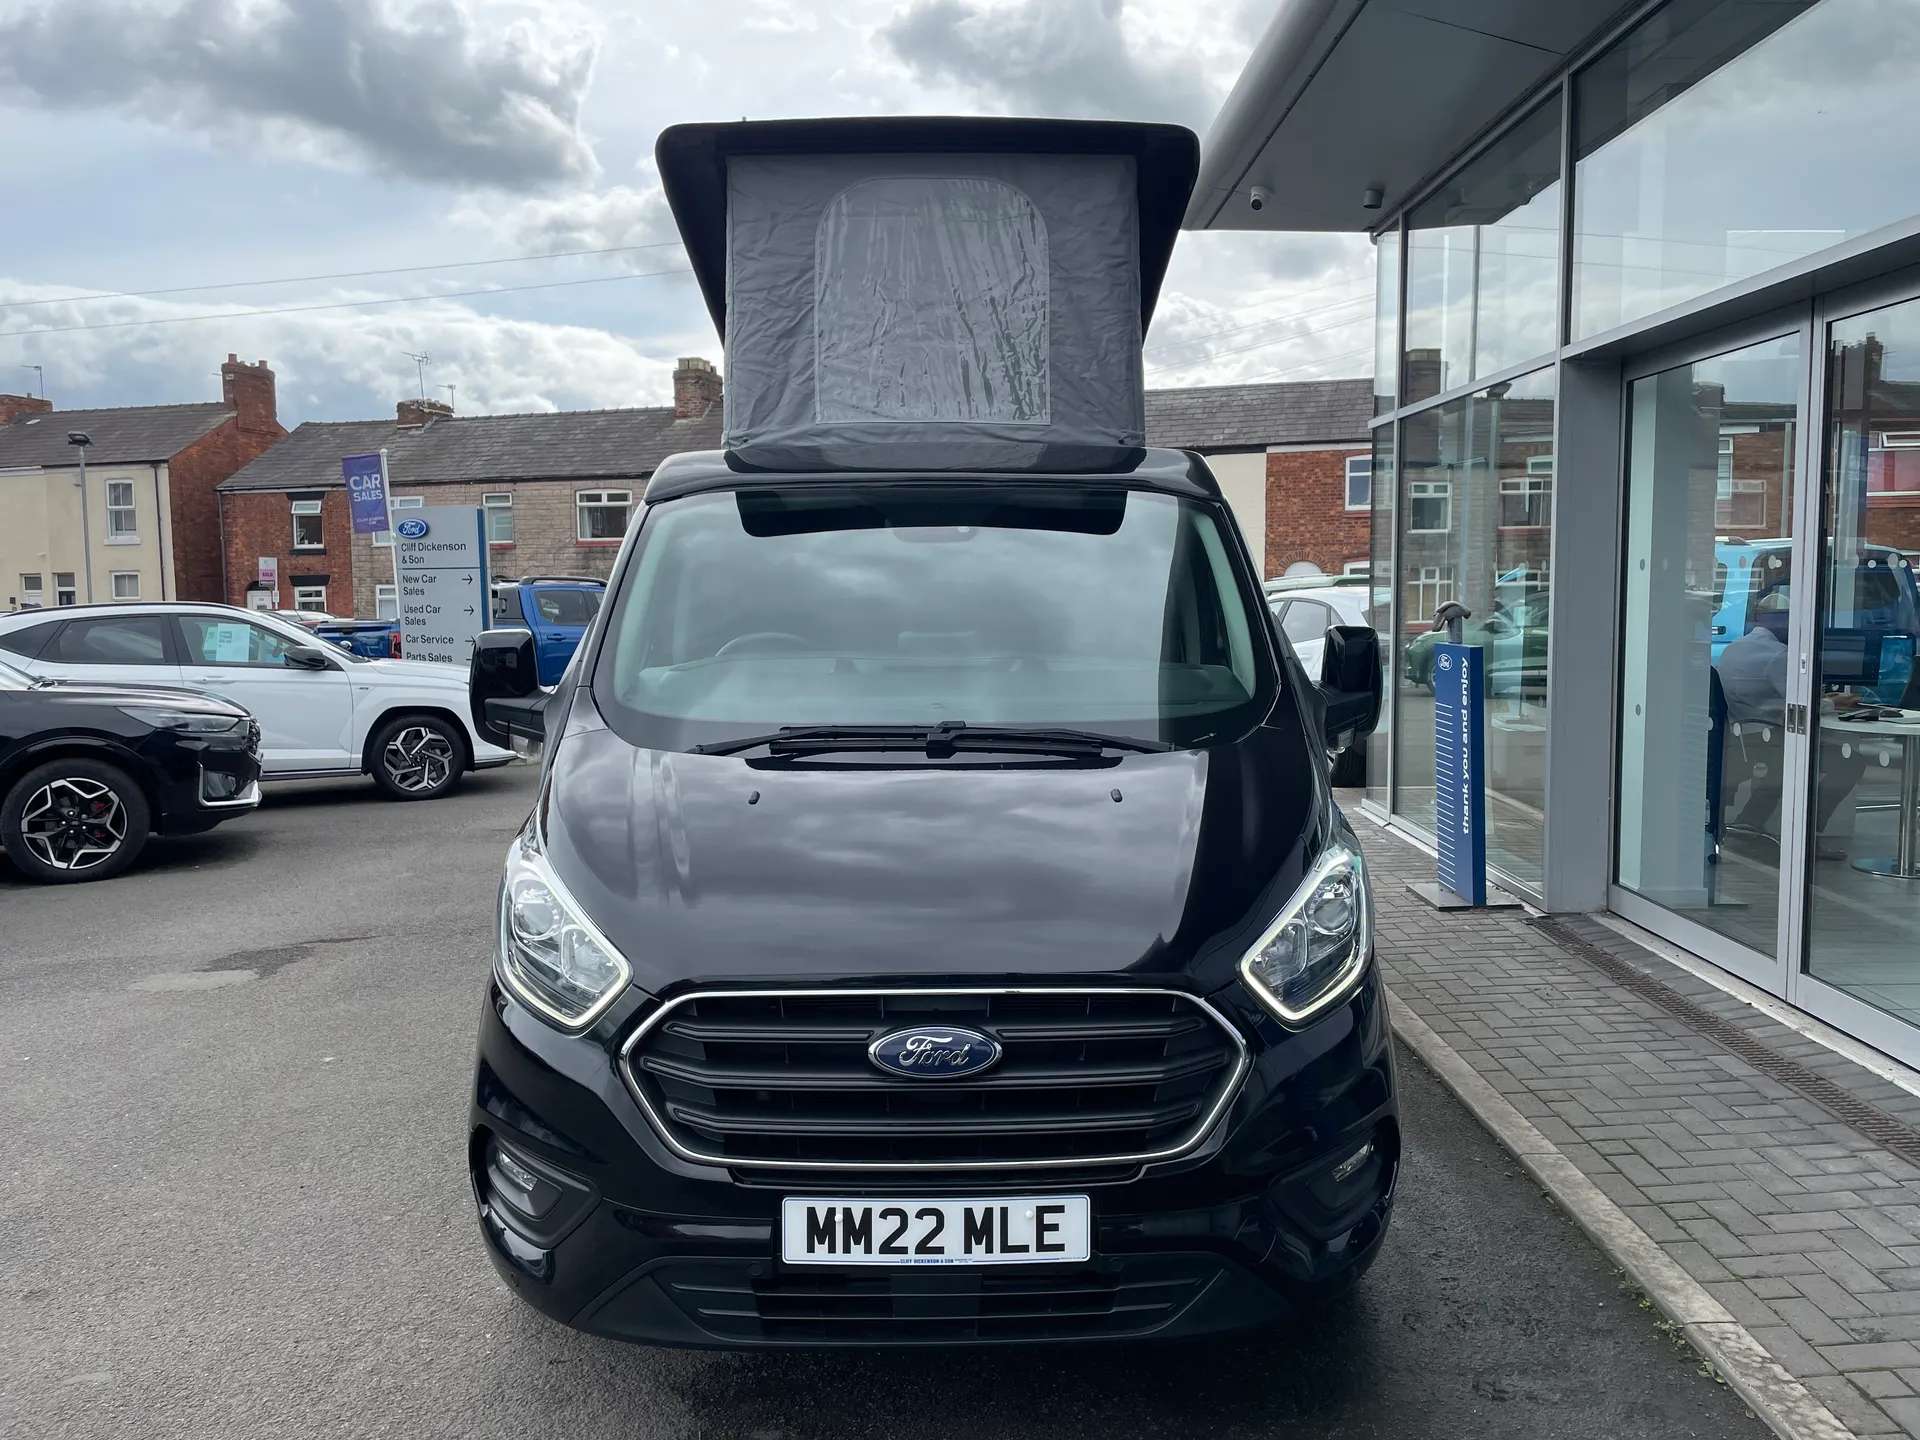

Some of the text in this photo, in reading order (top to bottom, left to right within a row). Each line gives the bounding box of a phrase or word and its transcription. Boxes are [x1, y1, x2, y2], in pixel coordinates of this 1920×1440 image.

[349, 474, 381, 490] CAR
[353, 489, 383, 502] SALES
[401, 541, 466, 552] Cliff Dickenson
[401, 554, 424, 564] & Son
[402, 574, 437, 584] New Car
[403, 586, 424, 596] Sales
[404, 604, 441, 614] Used Car
[404, 616, 426, 626] Sales
[405, 634, 454, 644] Car Service
[406, 652, 453, 662] Parts Sales
[1461, 656, 1469, 706] enjoy
[899, 1036, 971, 1066] Ford
[806, 1205, 1066, 1255] MM22 MLE
